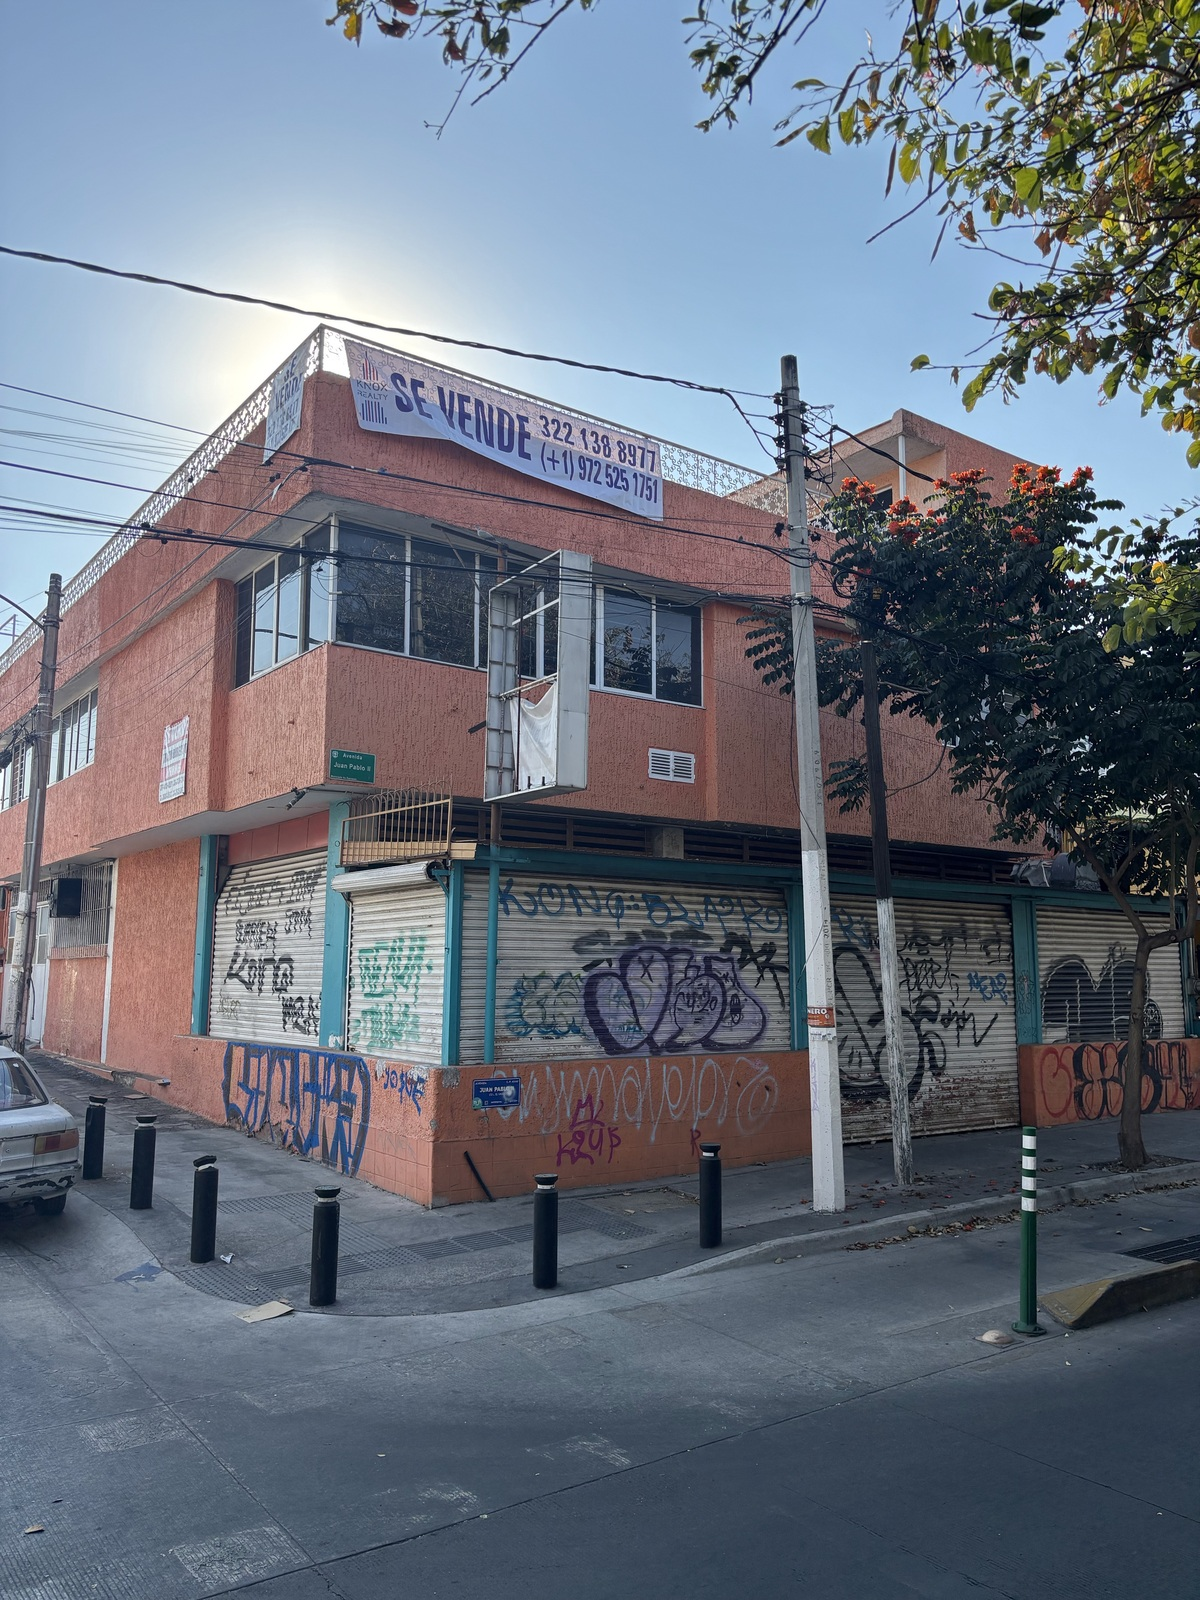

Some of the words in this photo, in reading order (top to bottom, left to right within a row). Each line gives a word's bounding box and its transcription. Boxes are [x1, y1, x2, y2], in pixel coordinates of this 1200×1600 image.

[357, 380, 388, 392] KNOX
[357, 391, 388, 401] REALTY
[390, 372, 433, 419] SE
[437, 386, 531, 461] VENDE
[540, 415, 574, 446] 322
[580, 428, 611, 458] 138
[617, 440, 655, 472] 8977
[540, 442, 574, 481] (+1)
[578, 455, 602, 485] 972
[605, 464, 629, 492] 525
[633, 473, 657, 504] 1751
[333, 761, 348, 769] Juan
[349, 763, 366, 772] Pablo
